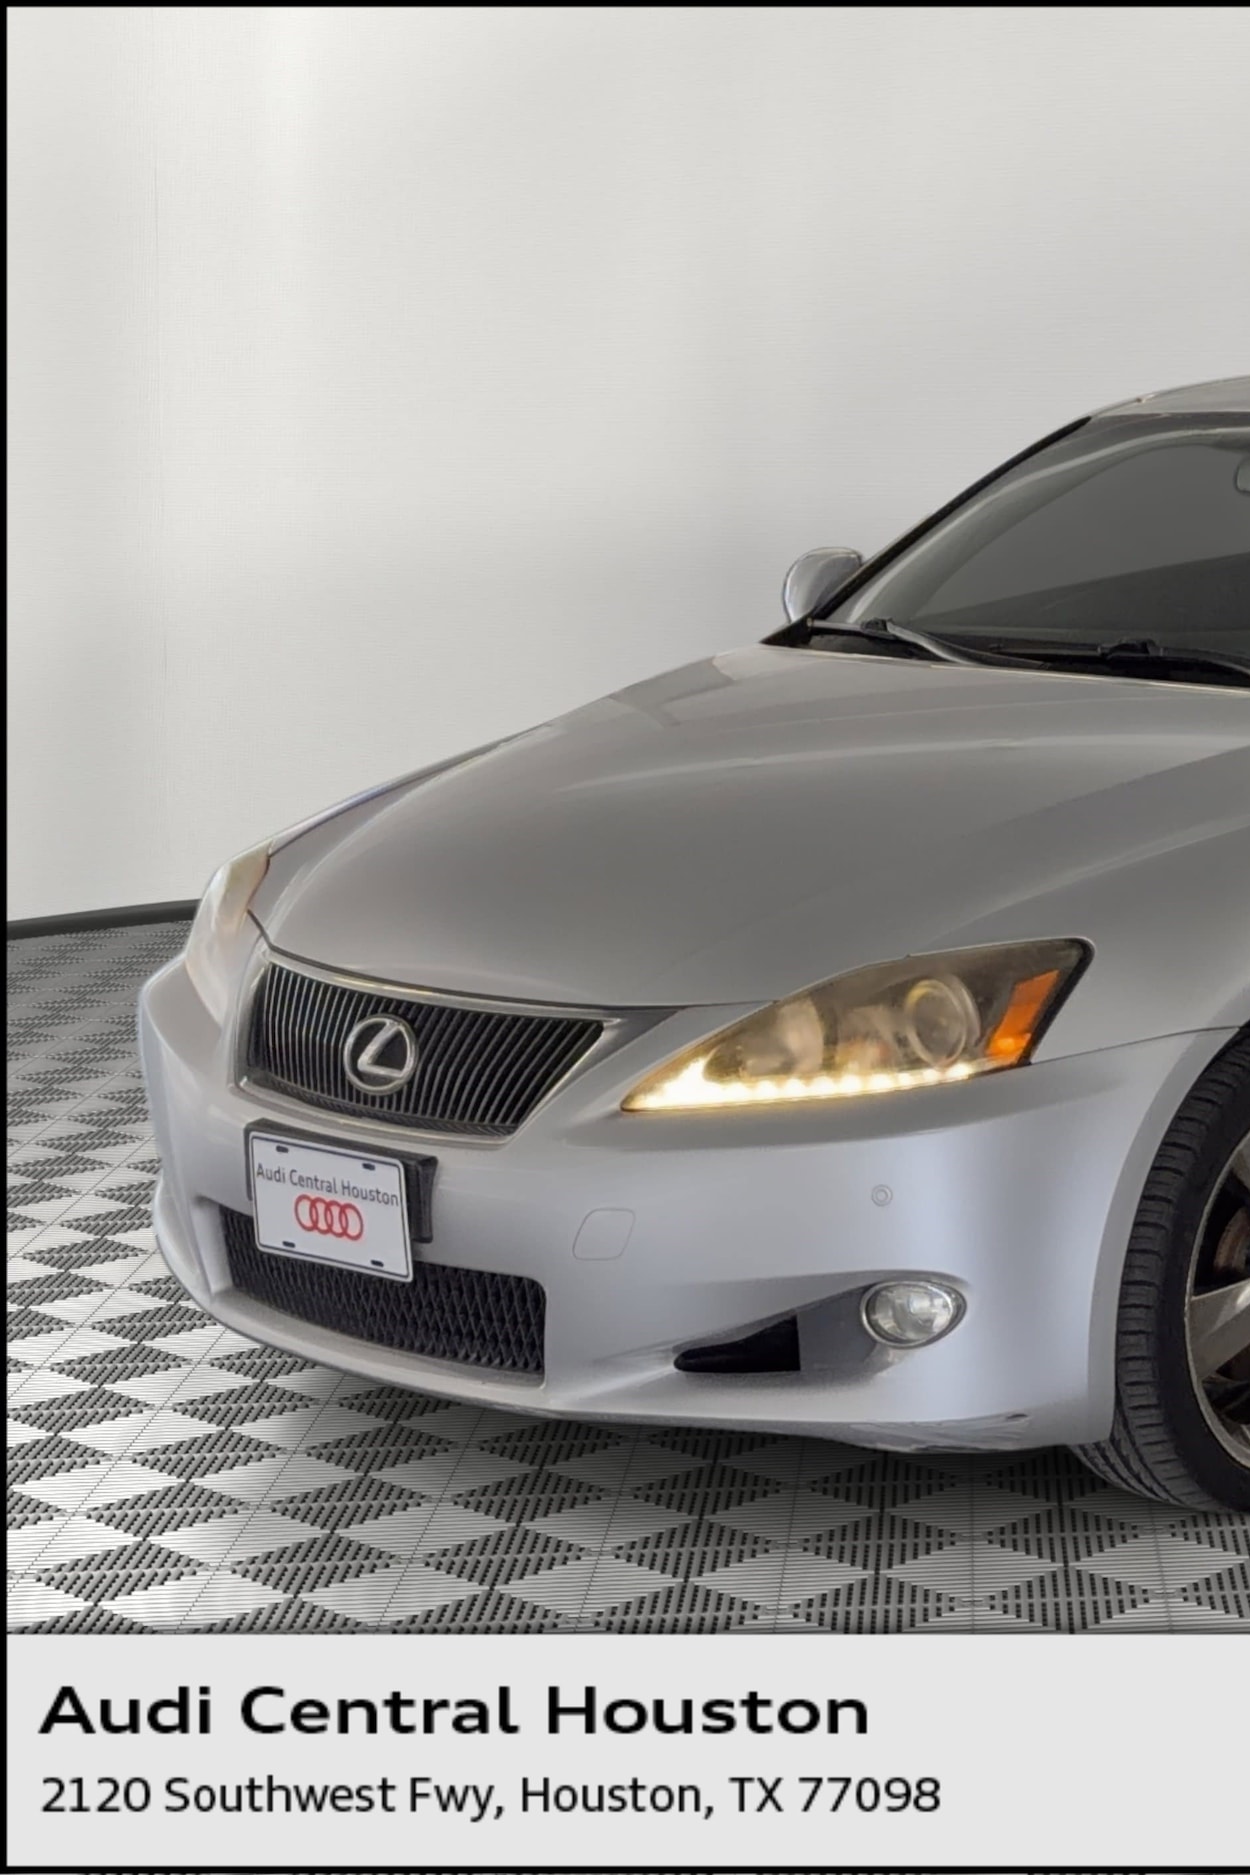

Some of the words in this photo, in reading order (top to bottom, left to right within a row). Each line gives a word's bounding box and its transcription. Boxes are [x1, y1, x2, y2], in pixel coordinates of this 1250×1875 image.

[256, 1162, 286, 1184] Audi
[289, 1169, 338, 1194] Central
[341, 1179, 399, 1206] Houston
